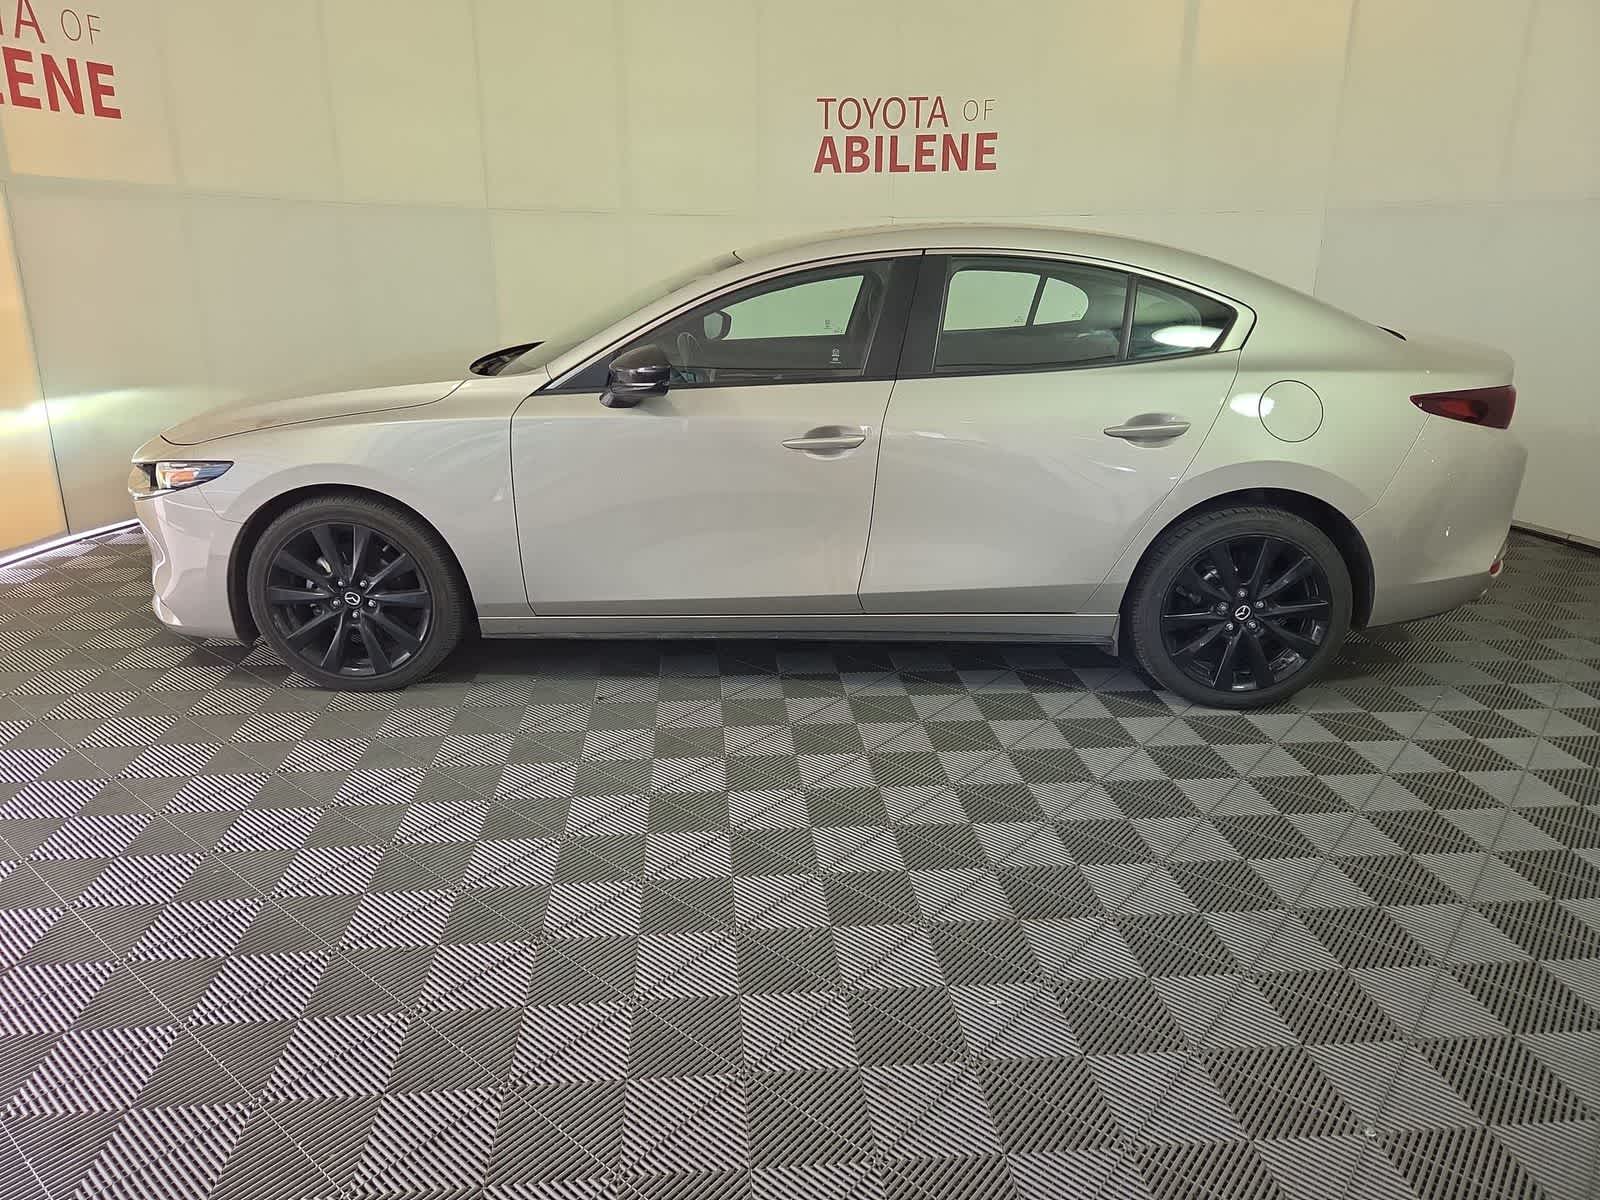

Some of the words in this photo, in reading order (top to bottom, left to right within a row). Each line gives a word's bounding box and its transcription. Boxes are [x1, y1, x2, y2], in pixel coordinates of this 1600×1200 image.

[0, 0, 46, 43] A
[60, 9, 101, 45] OF
[0, 46, 122, 119] ENE
[816, 95, 949, 130] TOYOTA
[963, 99, 996, 122] OF
[813, 132, 998, 174] ABILENE
